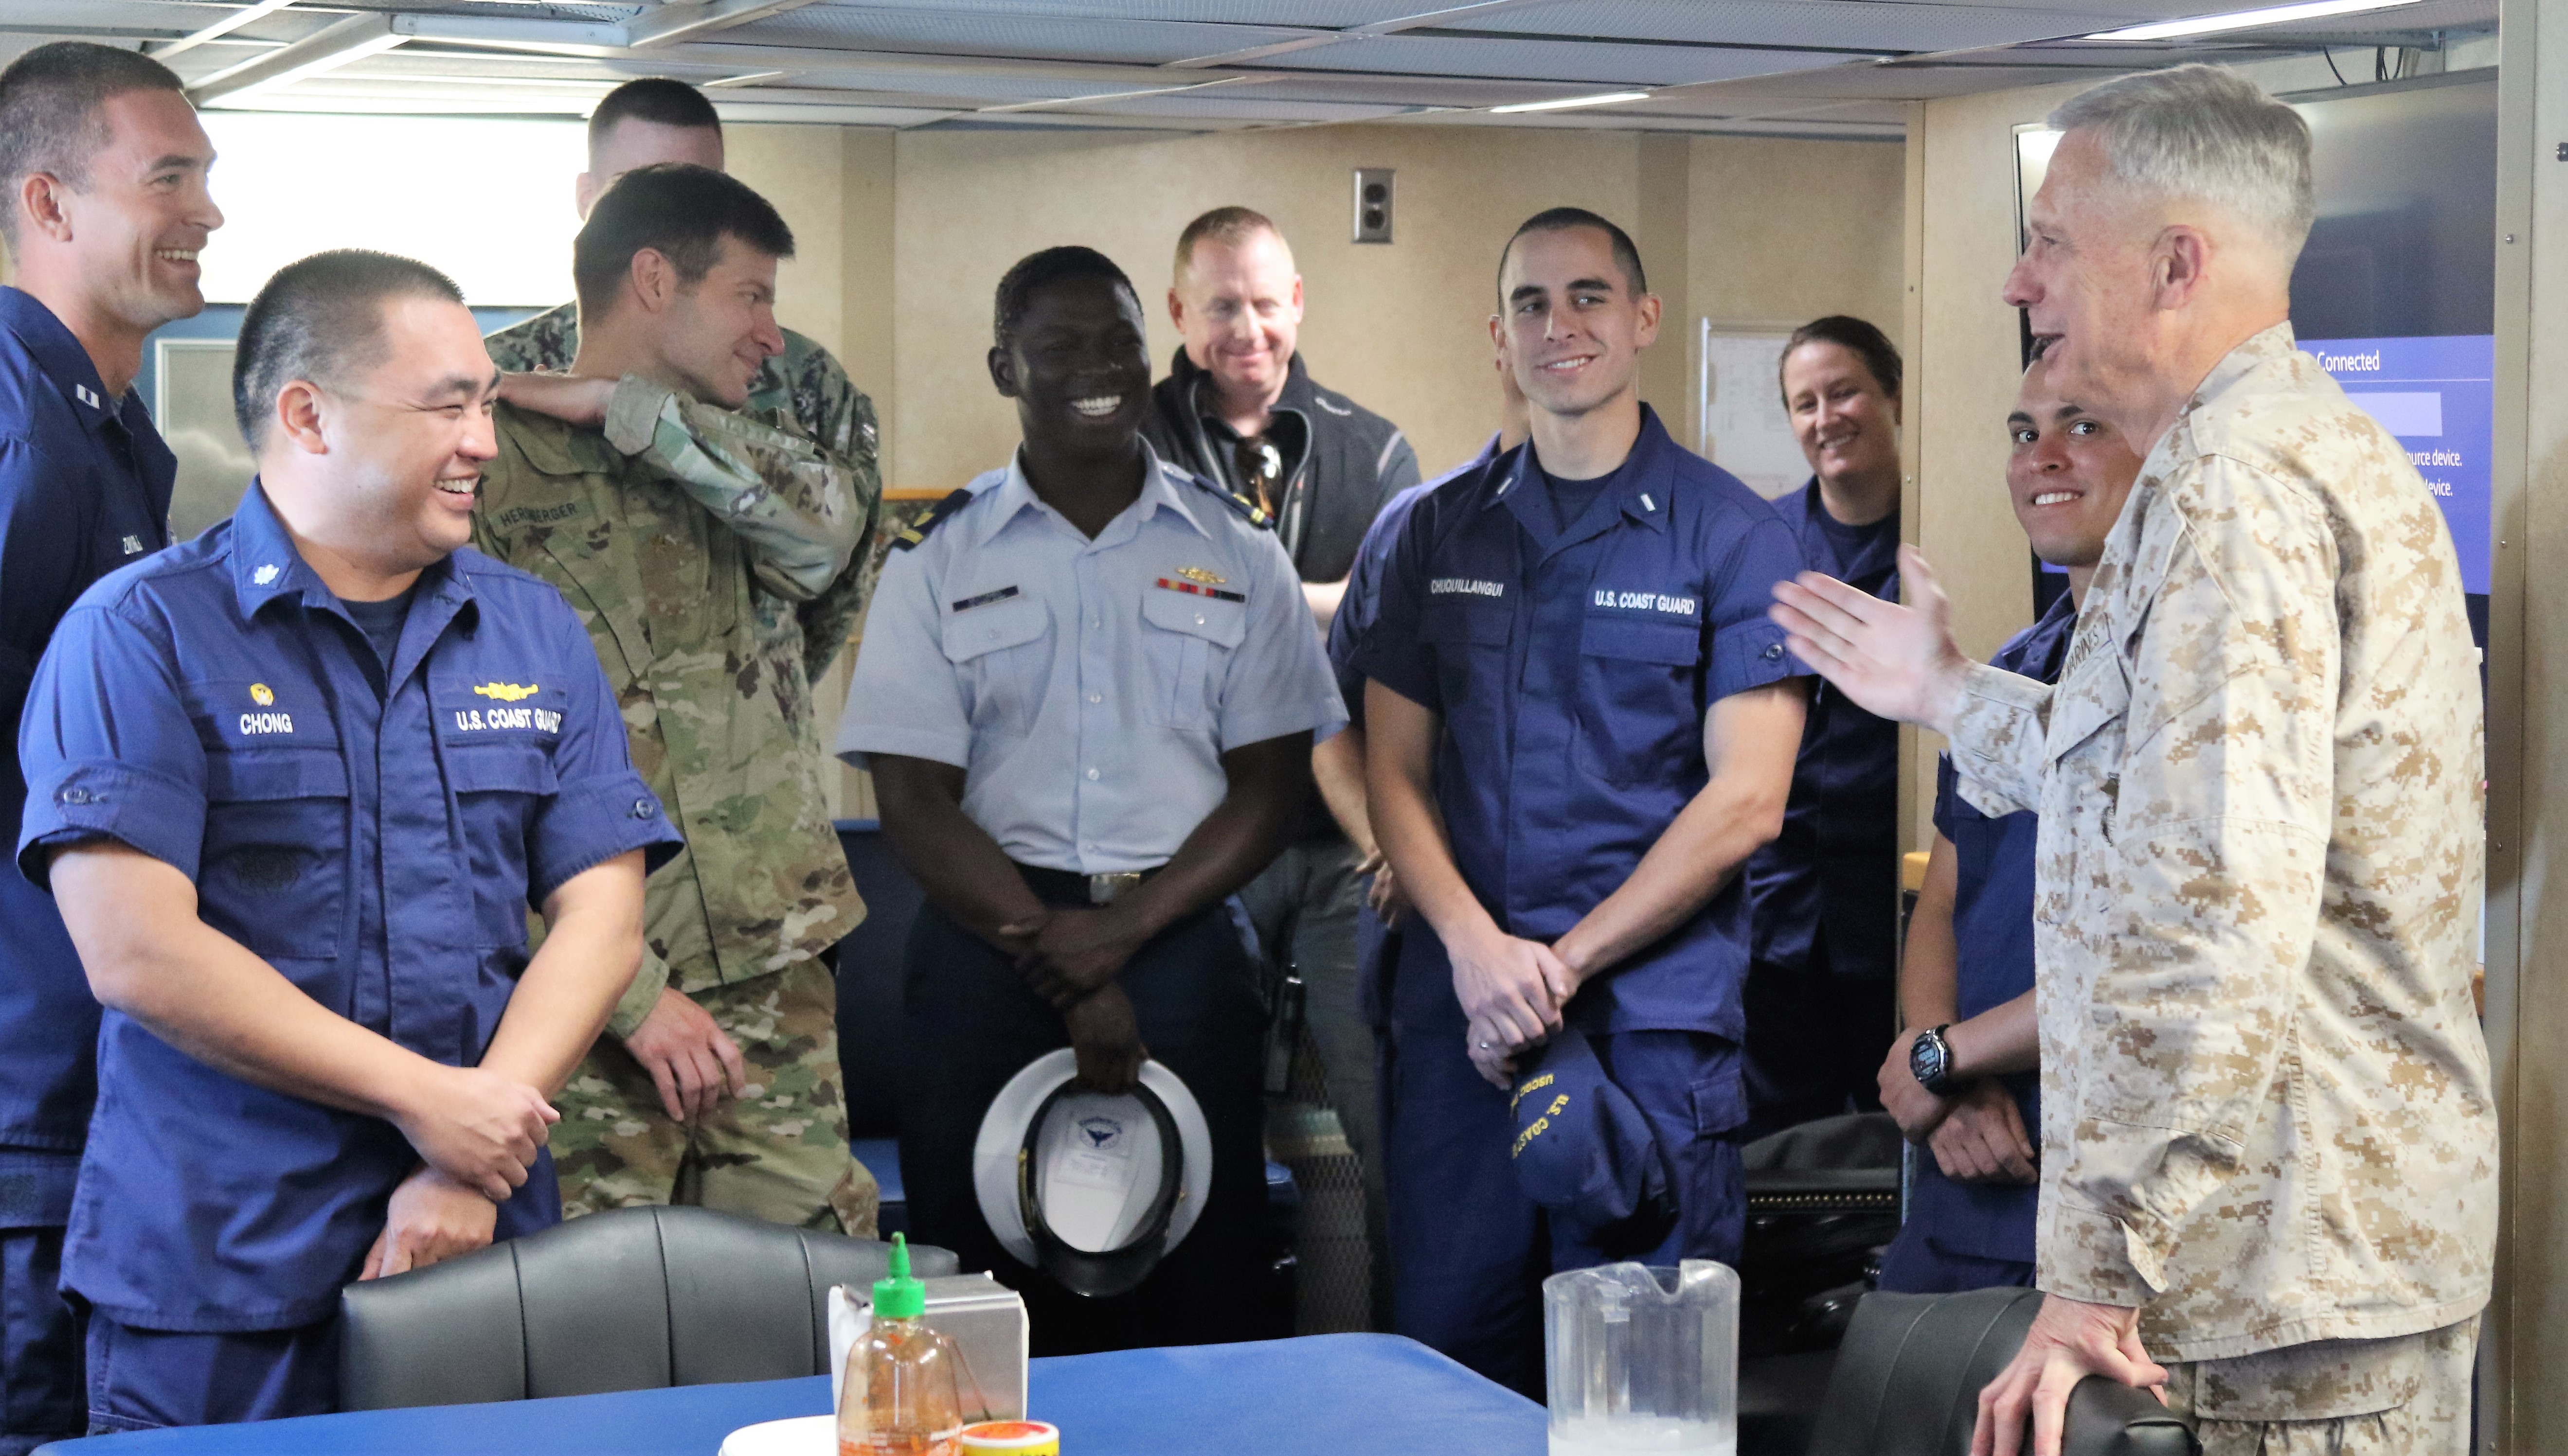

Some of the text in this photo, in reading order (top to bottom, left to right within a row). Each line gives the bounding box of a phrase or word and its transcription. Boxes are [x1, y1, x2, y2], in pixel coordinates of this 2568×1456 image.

[2317, 349, 2380, 372] Connected
[2432, 448, 2462, 466] device.
[1595, 590, 1695, 615] U.S. COAST GUARD
[240, 713, 293, 735] CHONG
[456, 710, 487, 731] U.S.
[487, 708, 532, 729] COAST
